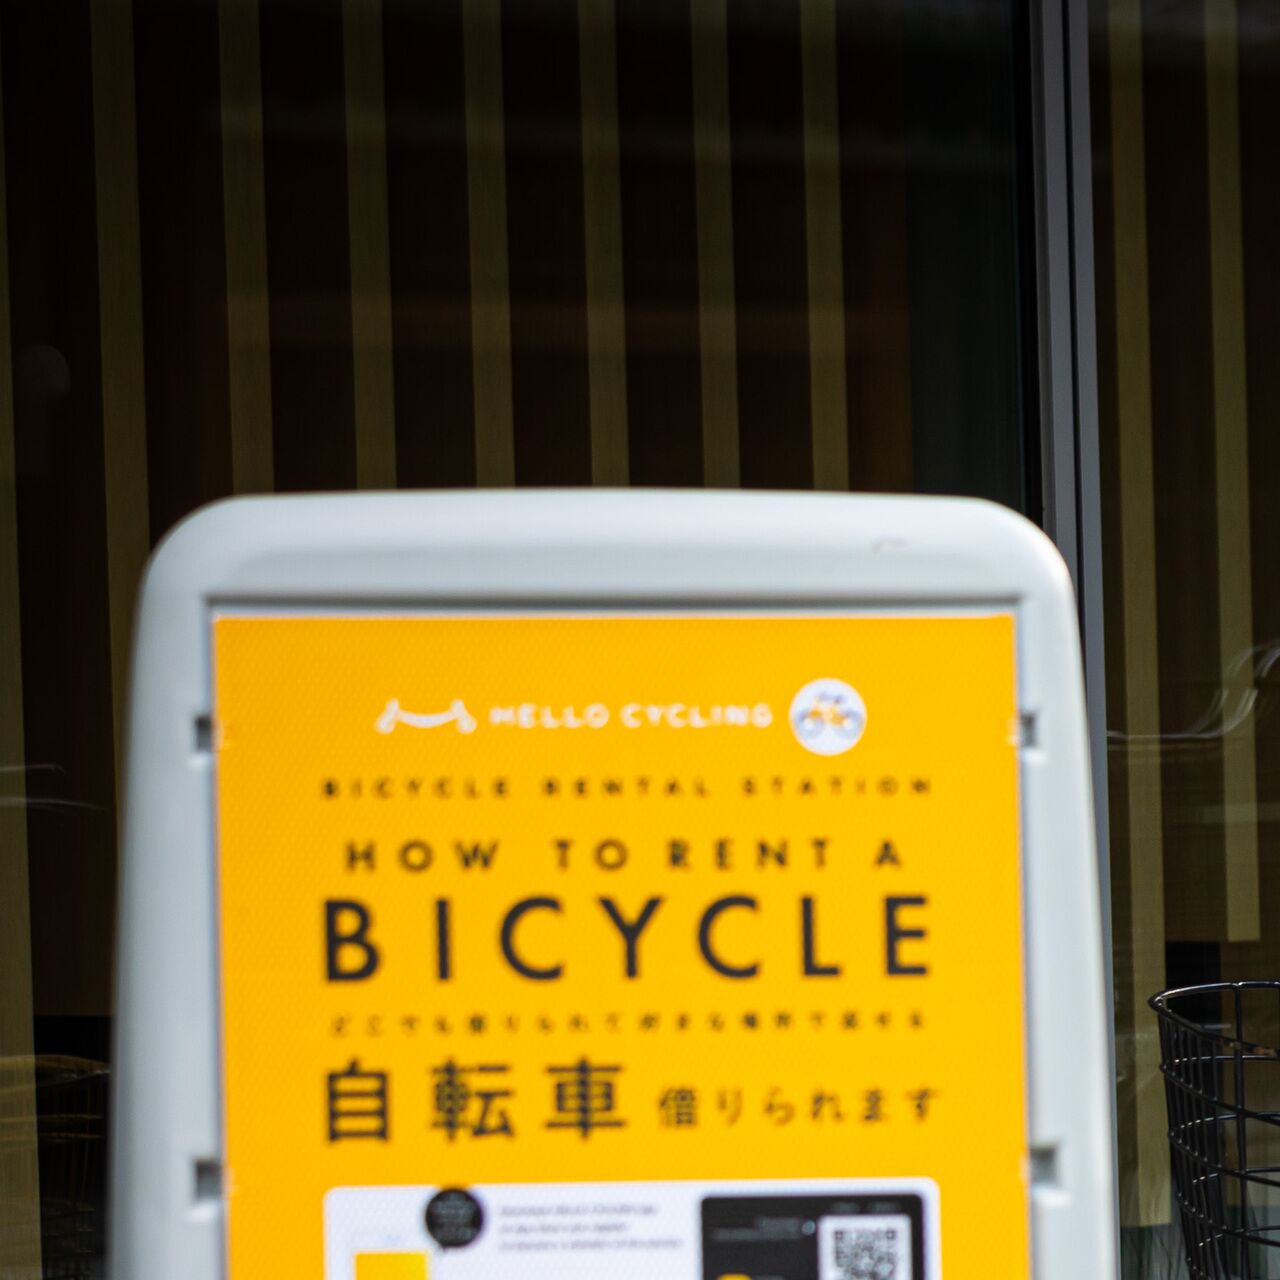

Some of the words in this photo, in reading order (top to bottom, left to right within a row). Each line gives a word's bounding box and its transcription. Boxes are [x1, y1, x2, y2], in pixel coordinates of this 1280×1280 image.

[488, 703, 610, 729] HELLO
[620, 703, 774, 729] CYCLING
[320, 776, 508, 801] BICYCLE
[541, 776, 709, 799] RENTAL
[740, 775, 933, 797] STATION
[345, 838, 499, 874] HOW
[553, 837, 630, 873] TO
[667, 836, 830, 872] RENT
[873, 838, 903, 869] A
[321, 892, 930, 985] BICYCLE
[325, 1056, 626, 1144] 自転車
[657, 1085, 937, 1130] 借りられます
